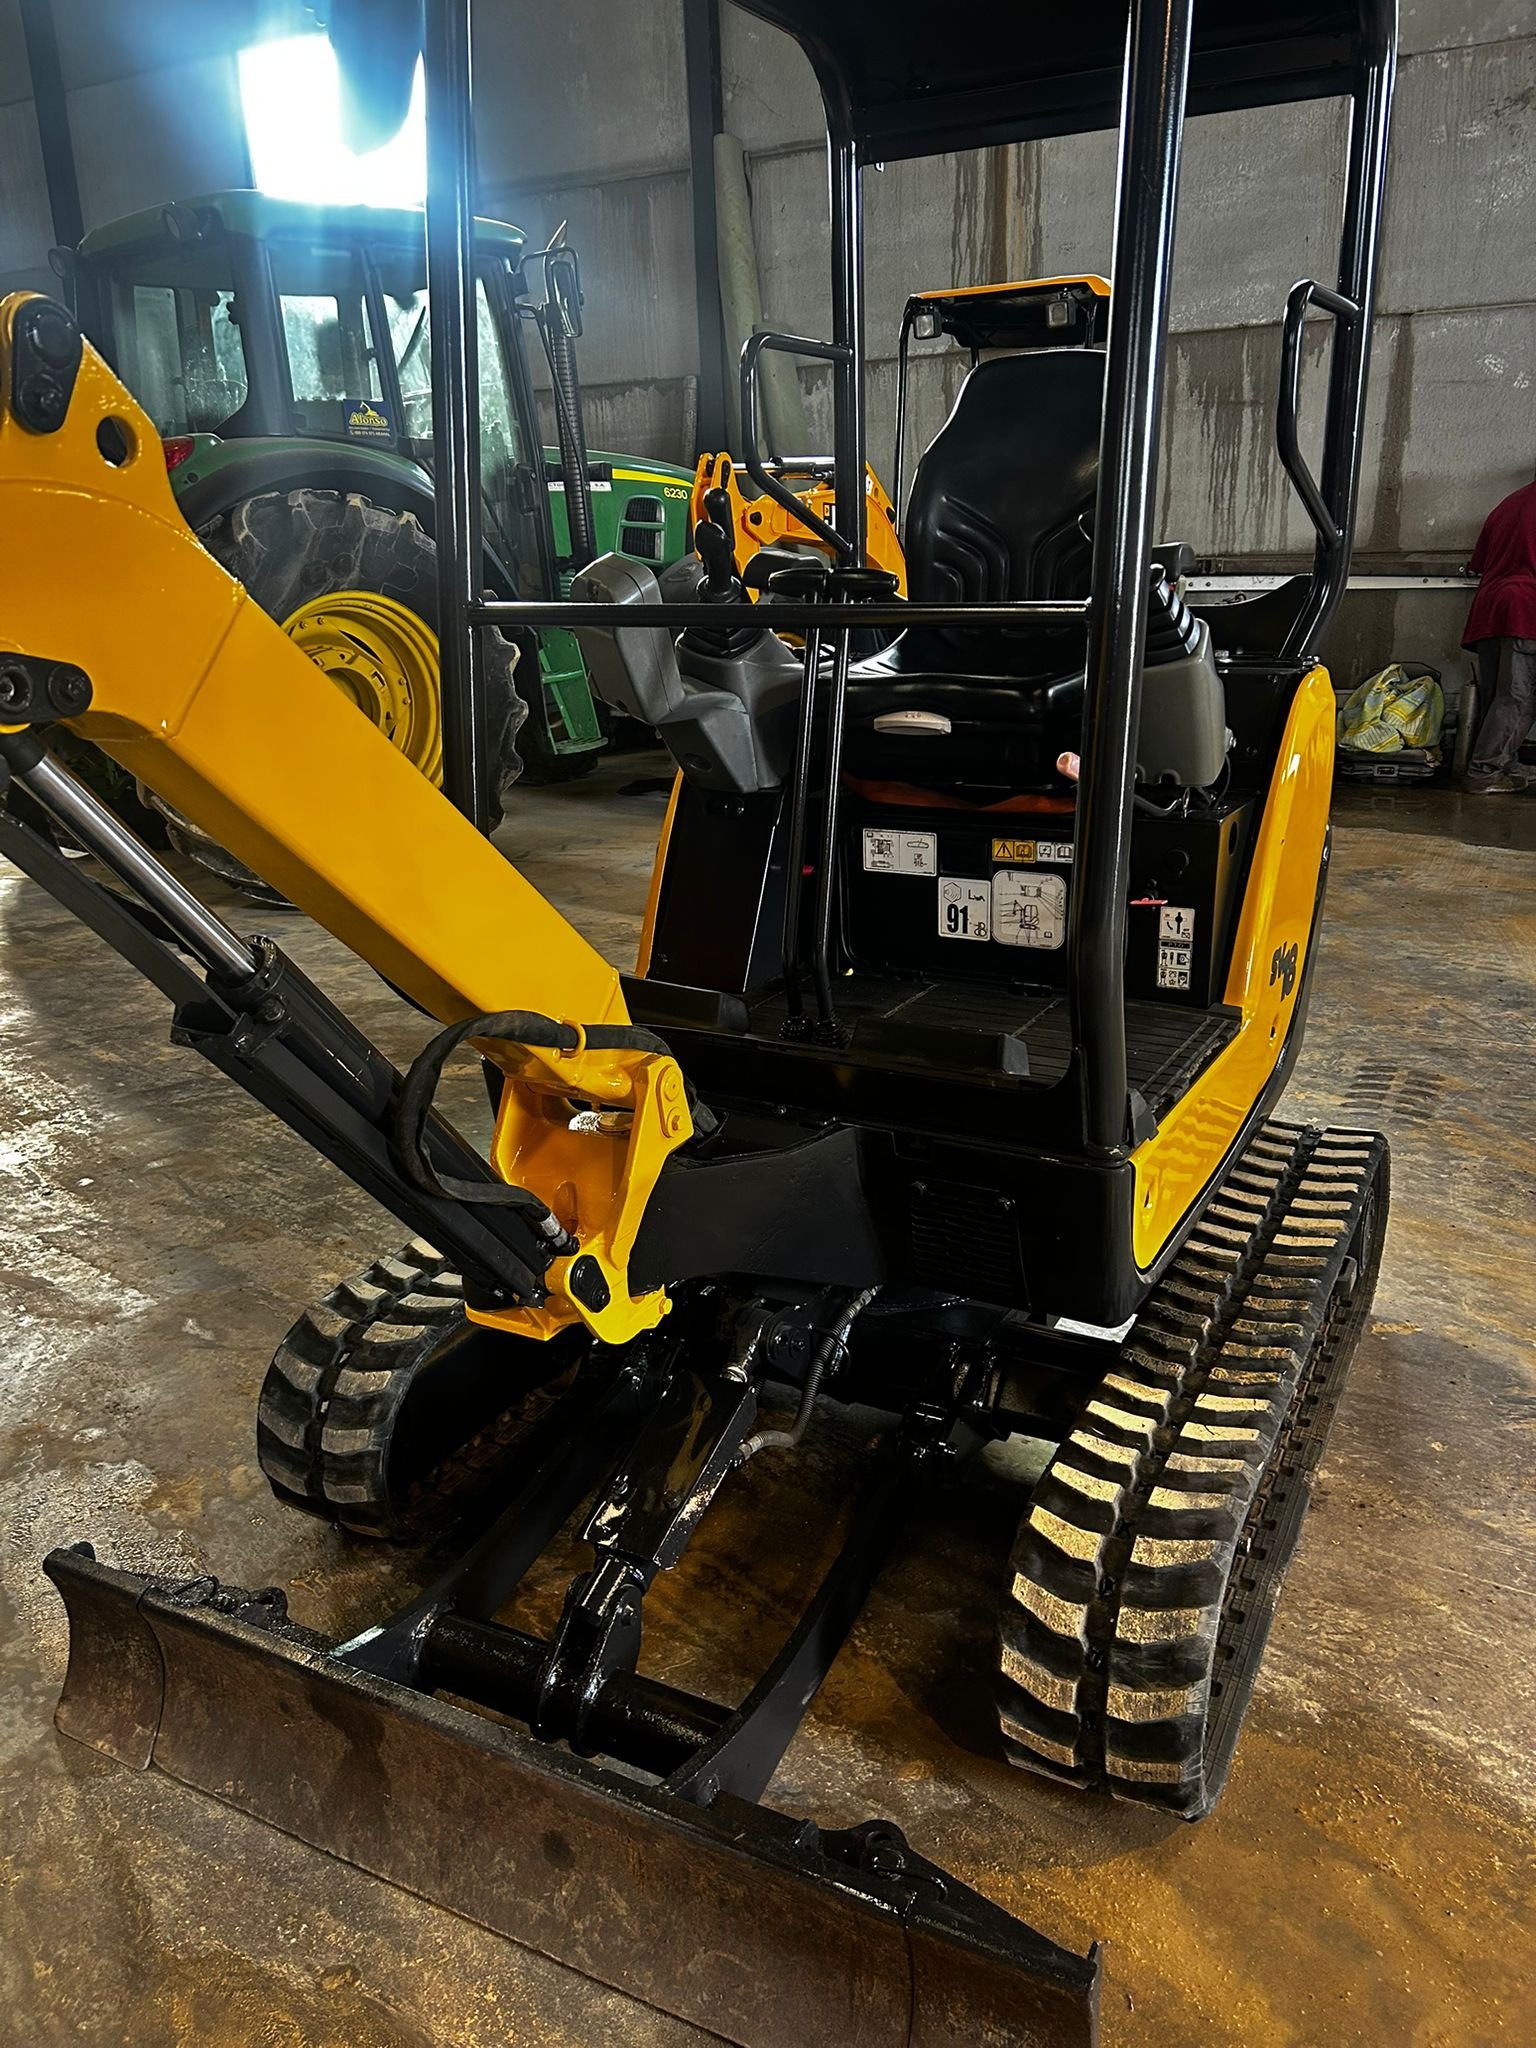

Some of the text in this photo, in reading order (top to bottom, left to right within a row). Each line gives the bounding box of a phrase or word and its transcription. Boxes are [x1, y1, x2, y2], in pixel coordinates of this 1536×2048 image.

[350, 412, 388, 427] Alonso
[663, 487, 688, 500] 6230
[947, 903, 968, 934] 91
